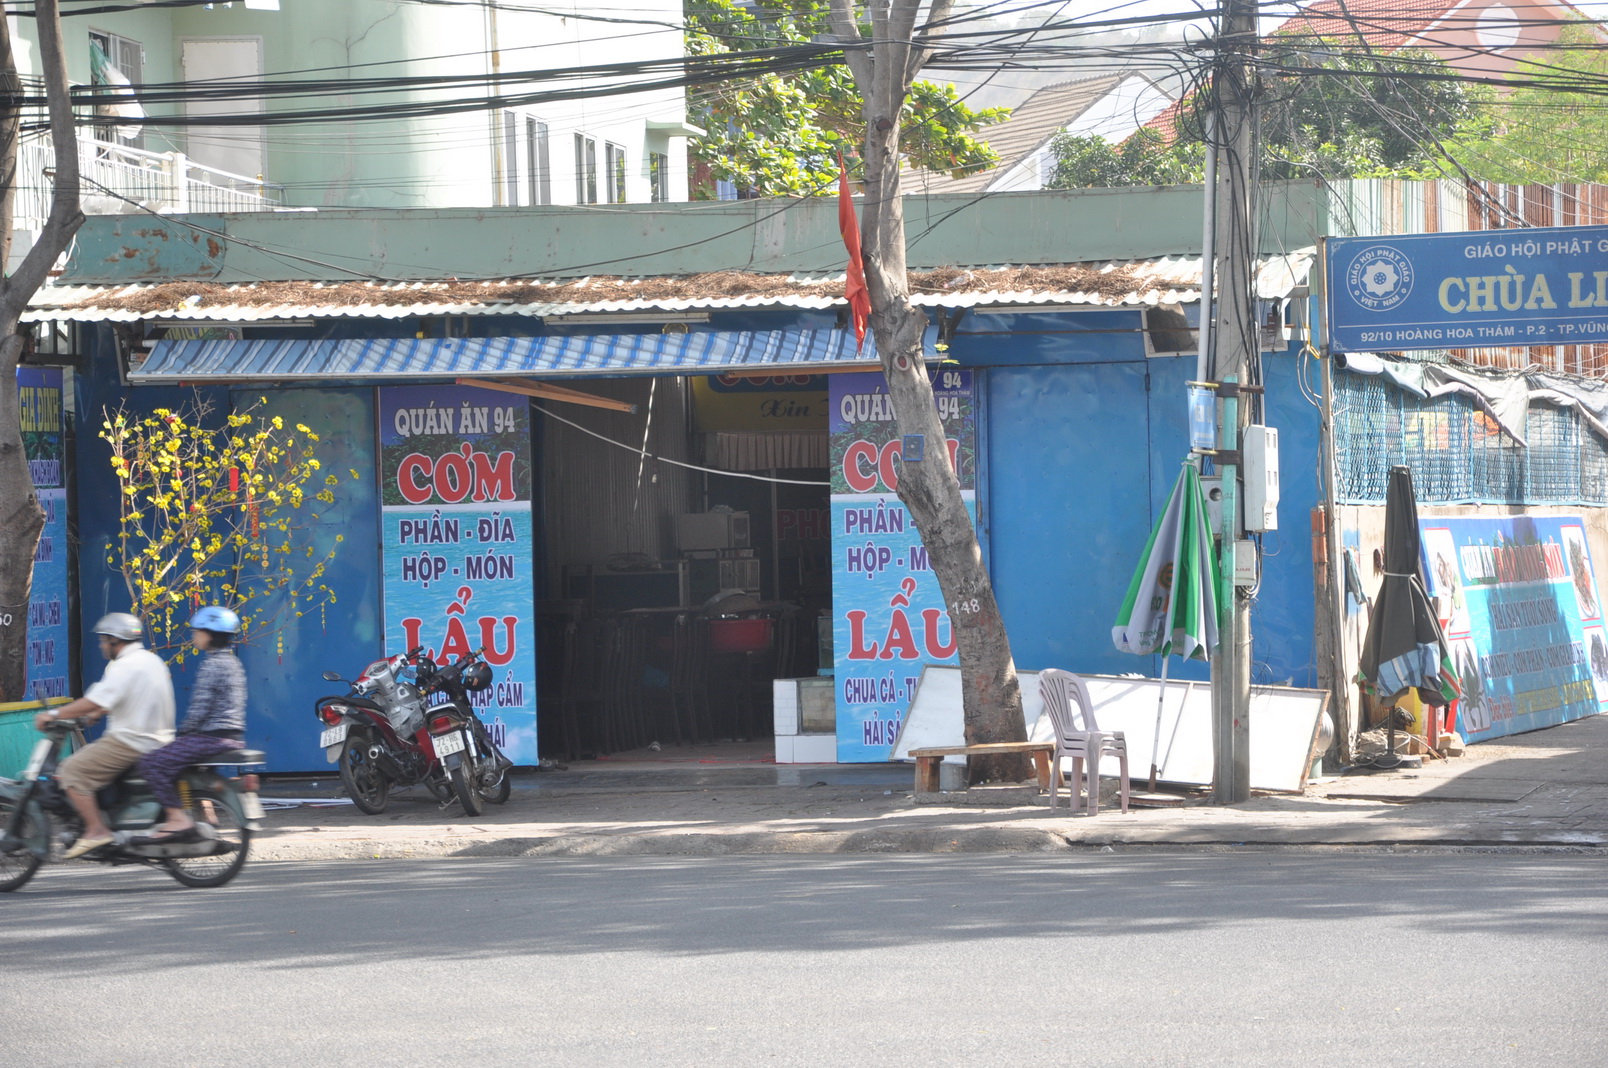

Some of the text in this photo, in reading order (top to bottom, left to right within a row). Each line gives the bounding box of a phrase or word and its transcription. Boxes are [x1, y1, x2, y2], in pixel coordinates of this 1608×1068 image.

[1464, 244, 1507, 259] GIÁO
[1511, 240, 1541, 259] HỘI
[1546, 238, 1593, 256] PHẬT
[1382, 294, 1400, 307] NAM
[1438, 264, 1558, 314] CHÙA
[1360, 331, 1393, 342] 92/10
[1396, 325, 1443, 341] HOÀNG
[1446, 328, 1474, 339] HOA
[1477, 323, 1515, 337] THÁM
[1526, 326, 1546, 336] P.2
[1557, 321, 1608, 335] TP.VŨN
[943, 371, 962, 389] 94
[394, 401, 516, 438] QUÁN ĂN 94
[938, 397, 960, 420] 94
[396, 441, 517, 504] CƠM
[399, 509, 460, 545] PHẦN
[477, 511, 517, 544] ĐĨA
[844, 498, 904, 535] PHẦN
[402, 551, 448, 588] HỘP
[465, 549, 514, 581] MÓN
[847, 541, 892, 579] HỘP
[401, 586, 519, 667] LẨU
[846, 577, 957, 661] LẨU
[497, 670, 524, 707] CẨM
[844, 678, 877, 704] CHUA
[880, 670, 896, 704] CÁ
[864, 710, 884, 746] HẢI
